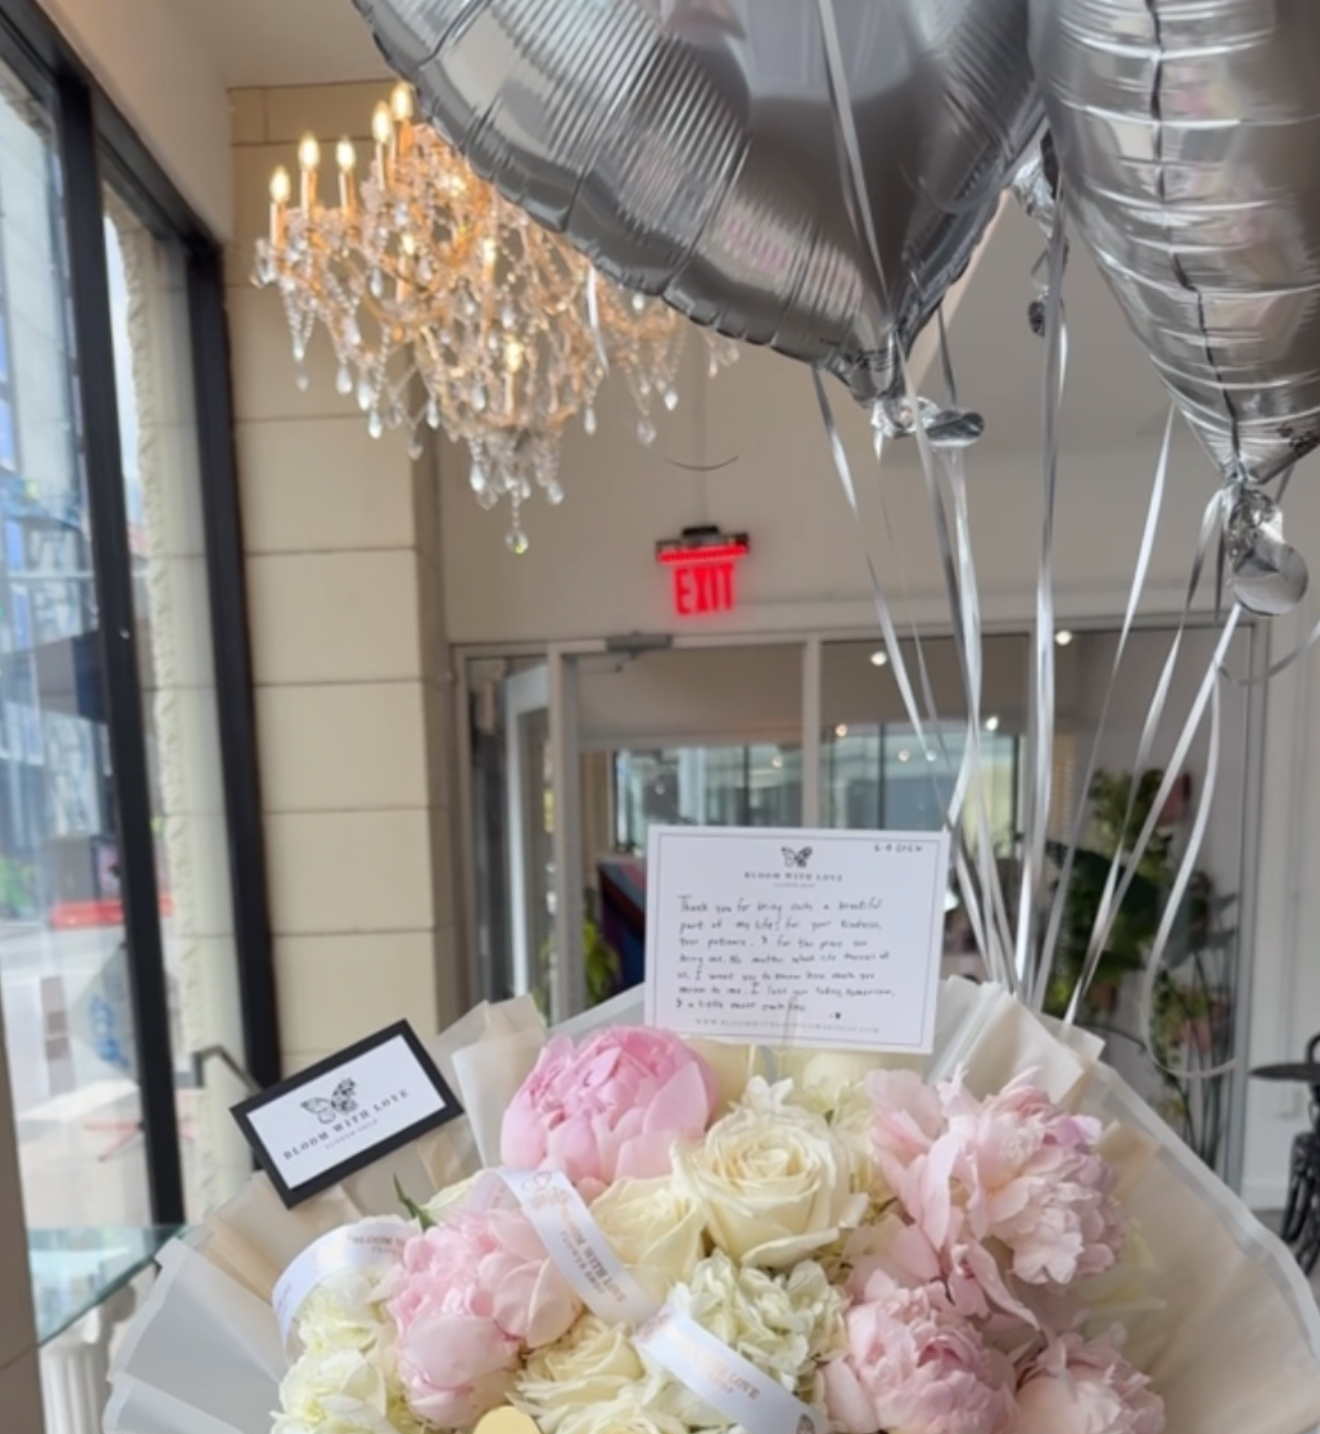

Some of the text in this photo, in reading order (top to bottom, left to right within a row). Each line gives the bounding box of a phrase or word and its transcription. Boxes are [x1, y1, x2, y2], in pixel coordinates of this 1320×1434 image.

[674, 563, 734, 615] EXIT
[744, 871, 843, 882] BLOOM WITH LOVE
[677, 894, 707, 912] Thank
[737, 896, 750, 912] for
[680, 920, 704, 935] part
[712, 918, 722, 929] of
[735, 921, 750, 932] my
[752, 954, 784, 964] matter
[283, 1087, 410, 1161] BLOOM WITH LOVE
